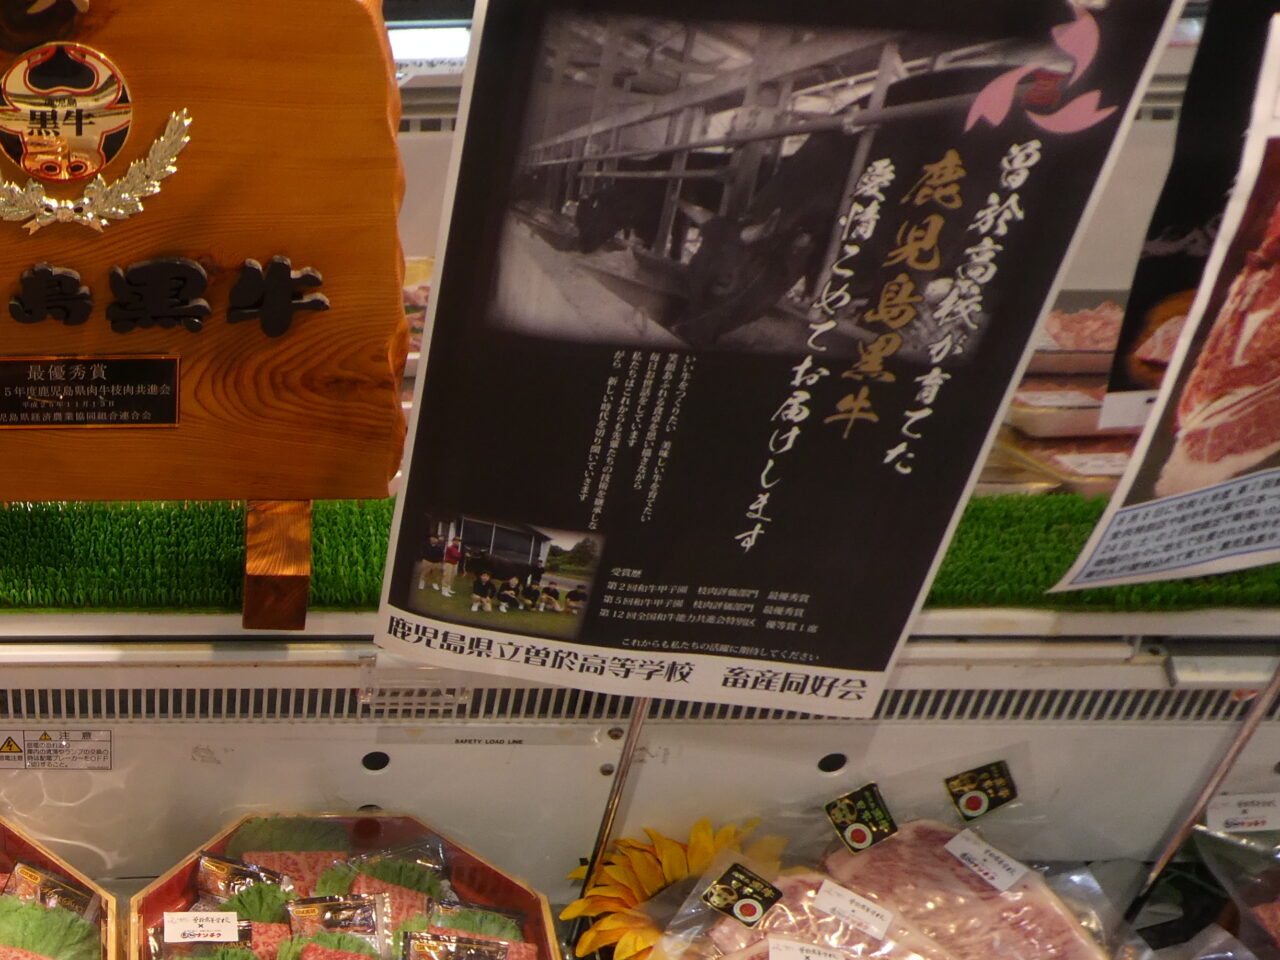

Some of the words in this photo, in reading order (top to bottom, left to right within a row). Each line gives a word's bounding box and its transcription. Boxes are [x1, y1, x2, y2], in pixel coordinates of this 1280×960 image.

[26, 108, 96, 138] 黒牛
[823, 150, 967, 440] 鹿児島黒牛
[882, 140, 1043, 475] 曽於高校が育てた
[27, 363, 108, 381] 最優秀賞
[665, 355, 697, 432] いい牛をつくりたい
[734, 158, 896, 554] 愛情こめてお届けします
[762, 604, 805, 618] 最優秀賞
[767, 590, 811, 603] 最優秀賞
[387, 615, 695, 684] 鹿児島県立曽於高等学校
[721, 665, 868, 701] 畜産同好会
